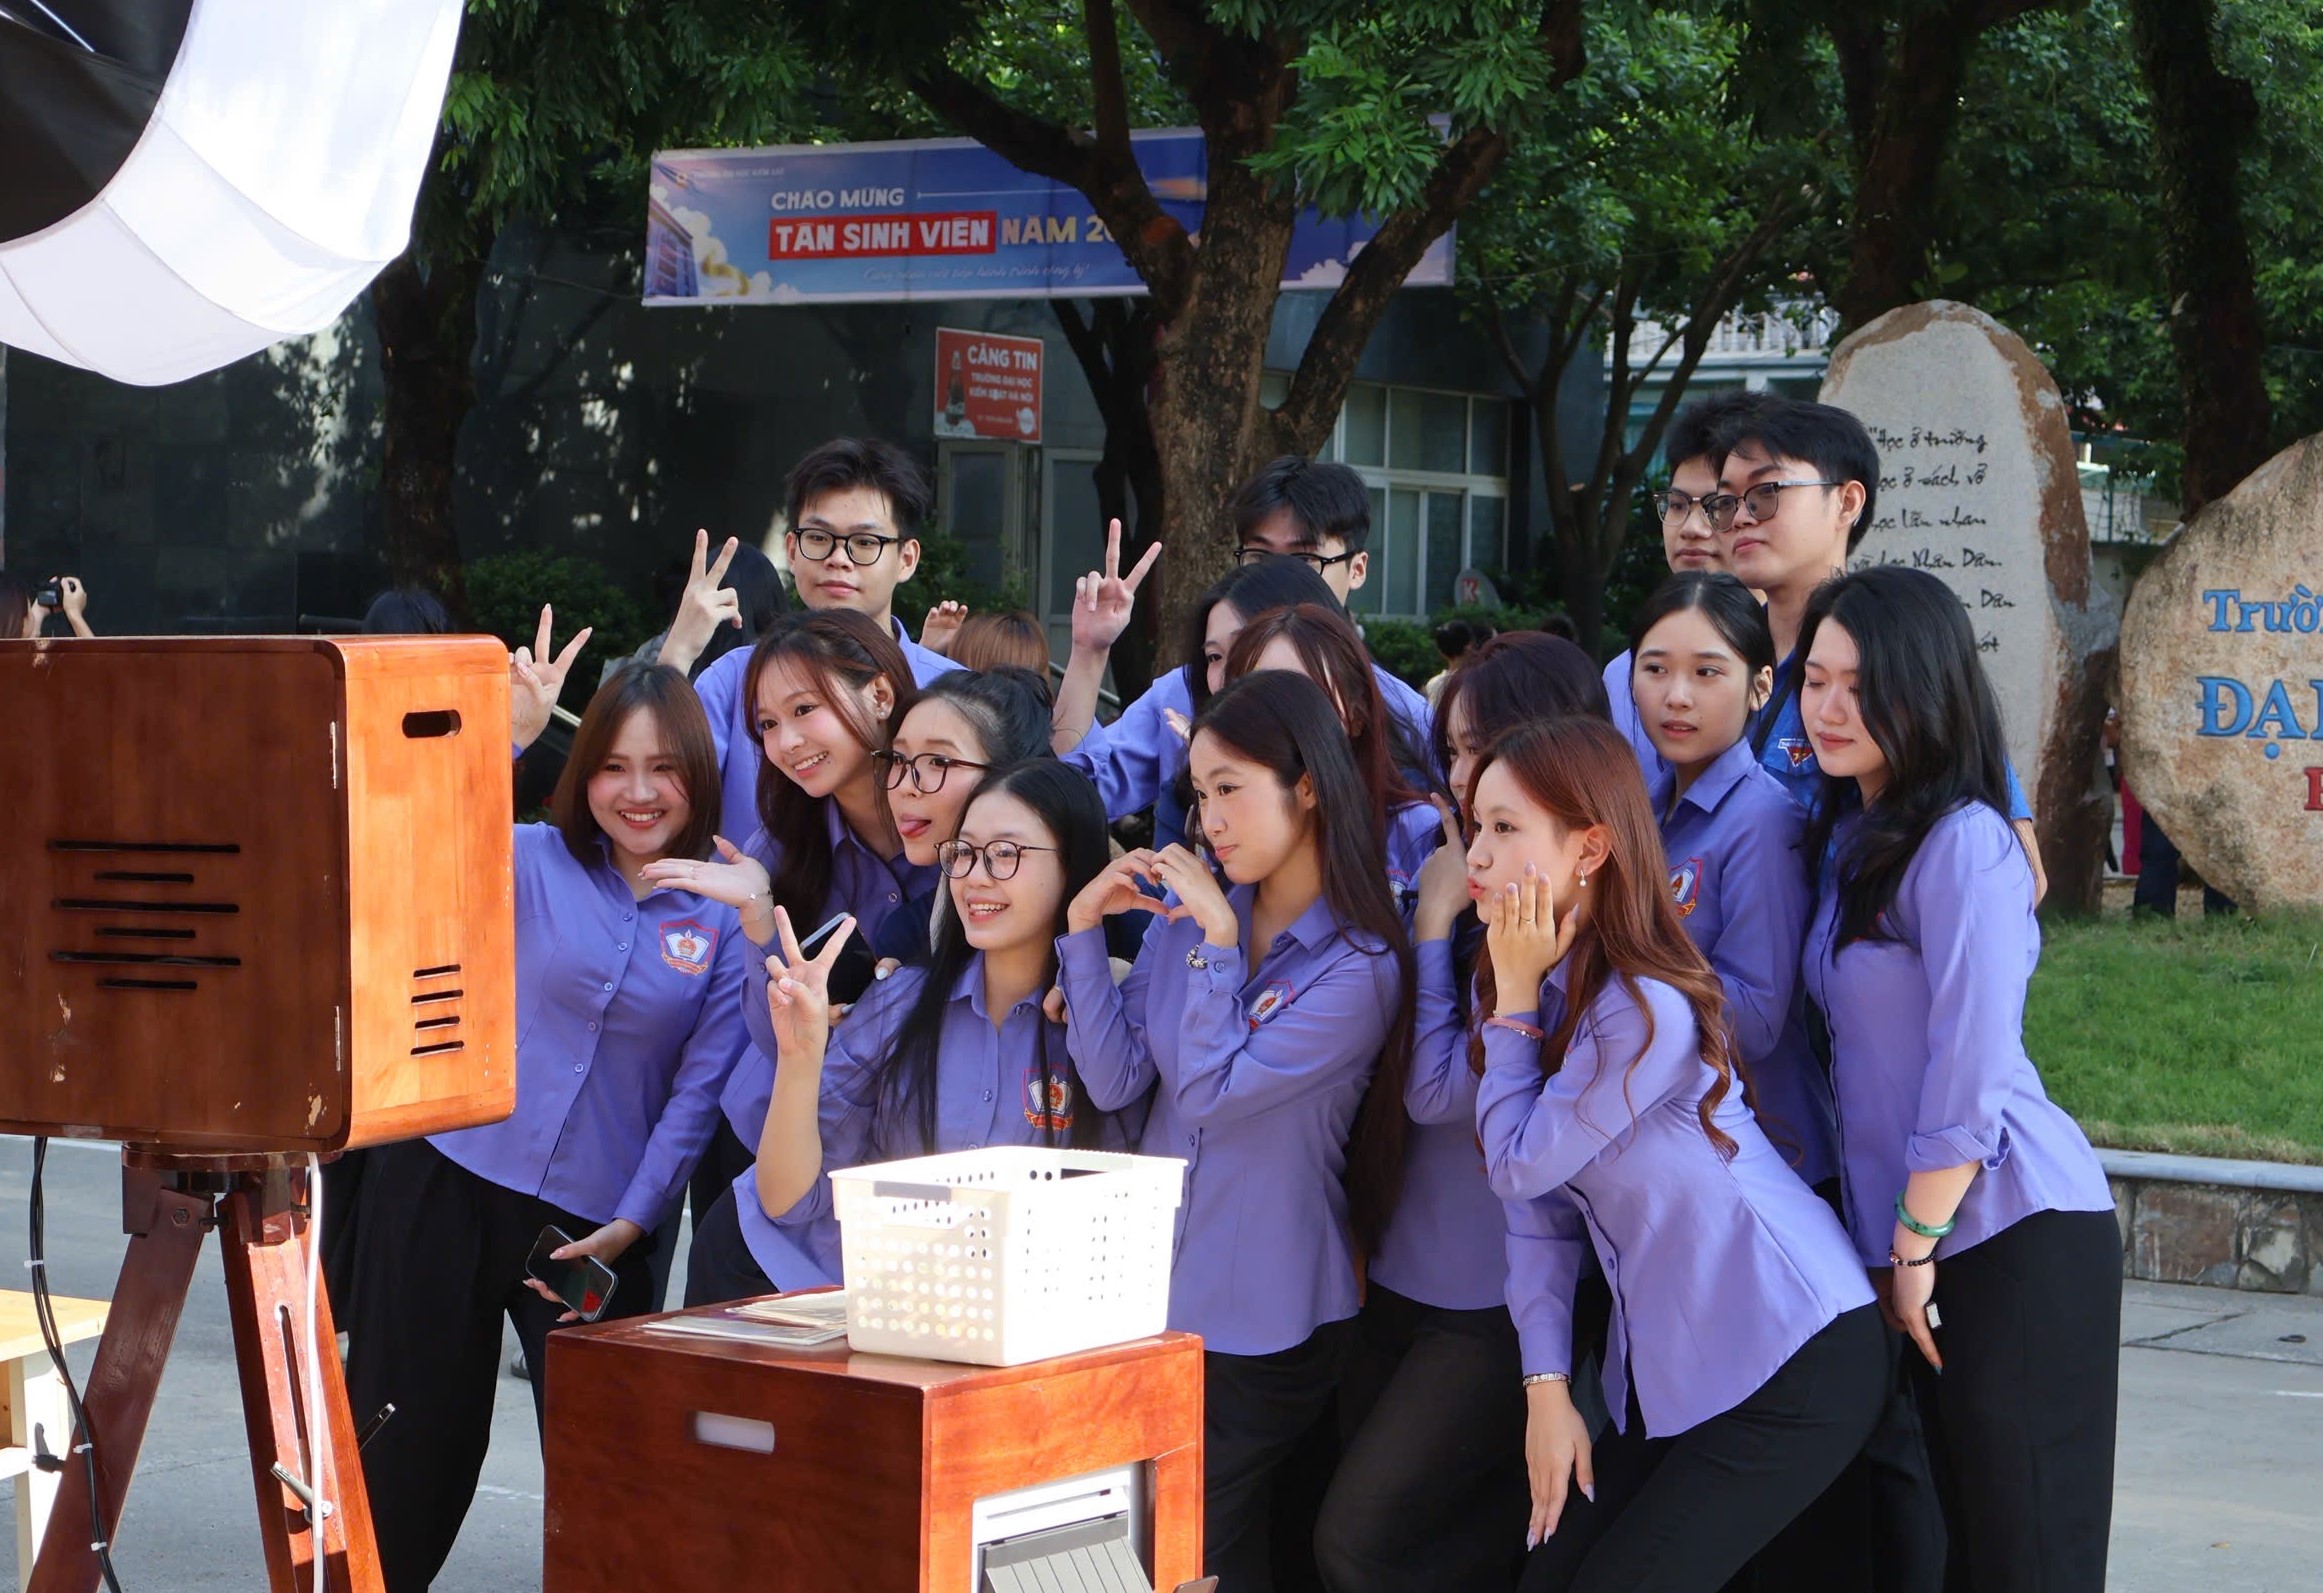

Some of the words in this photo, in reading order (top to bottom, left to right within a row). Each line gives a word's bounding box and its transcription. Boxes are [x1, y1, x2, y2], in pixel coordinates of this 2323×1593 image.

[843, 222, 910, 251] SINH
[1013, 350, 1037, 371] TIN
[2203, 583, 2323, 634] Trườ
